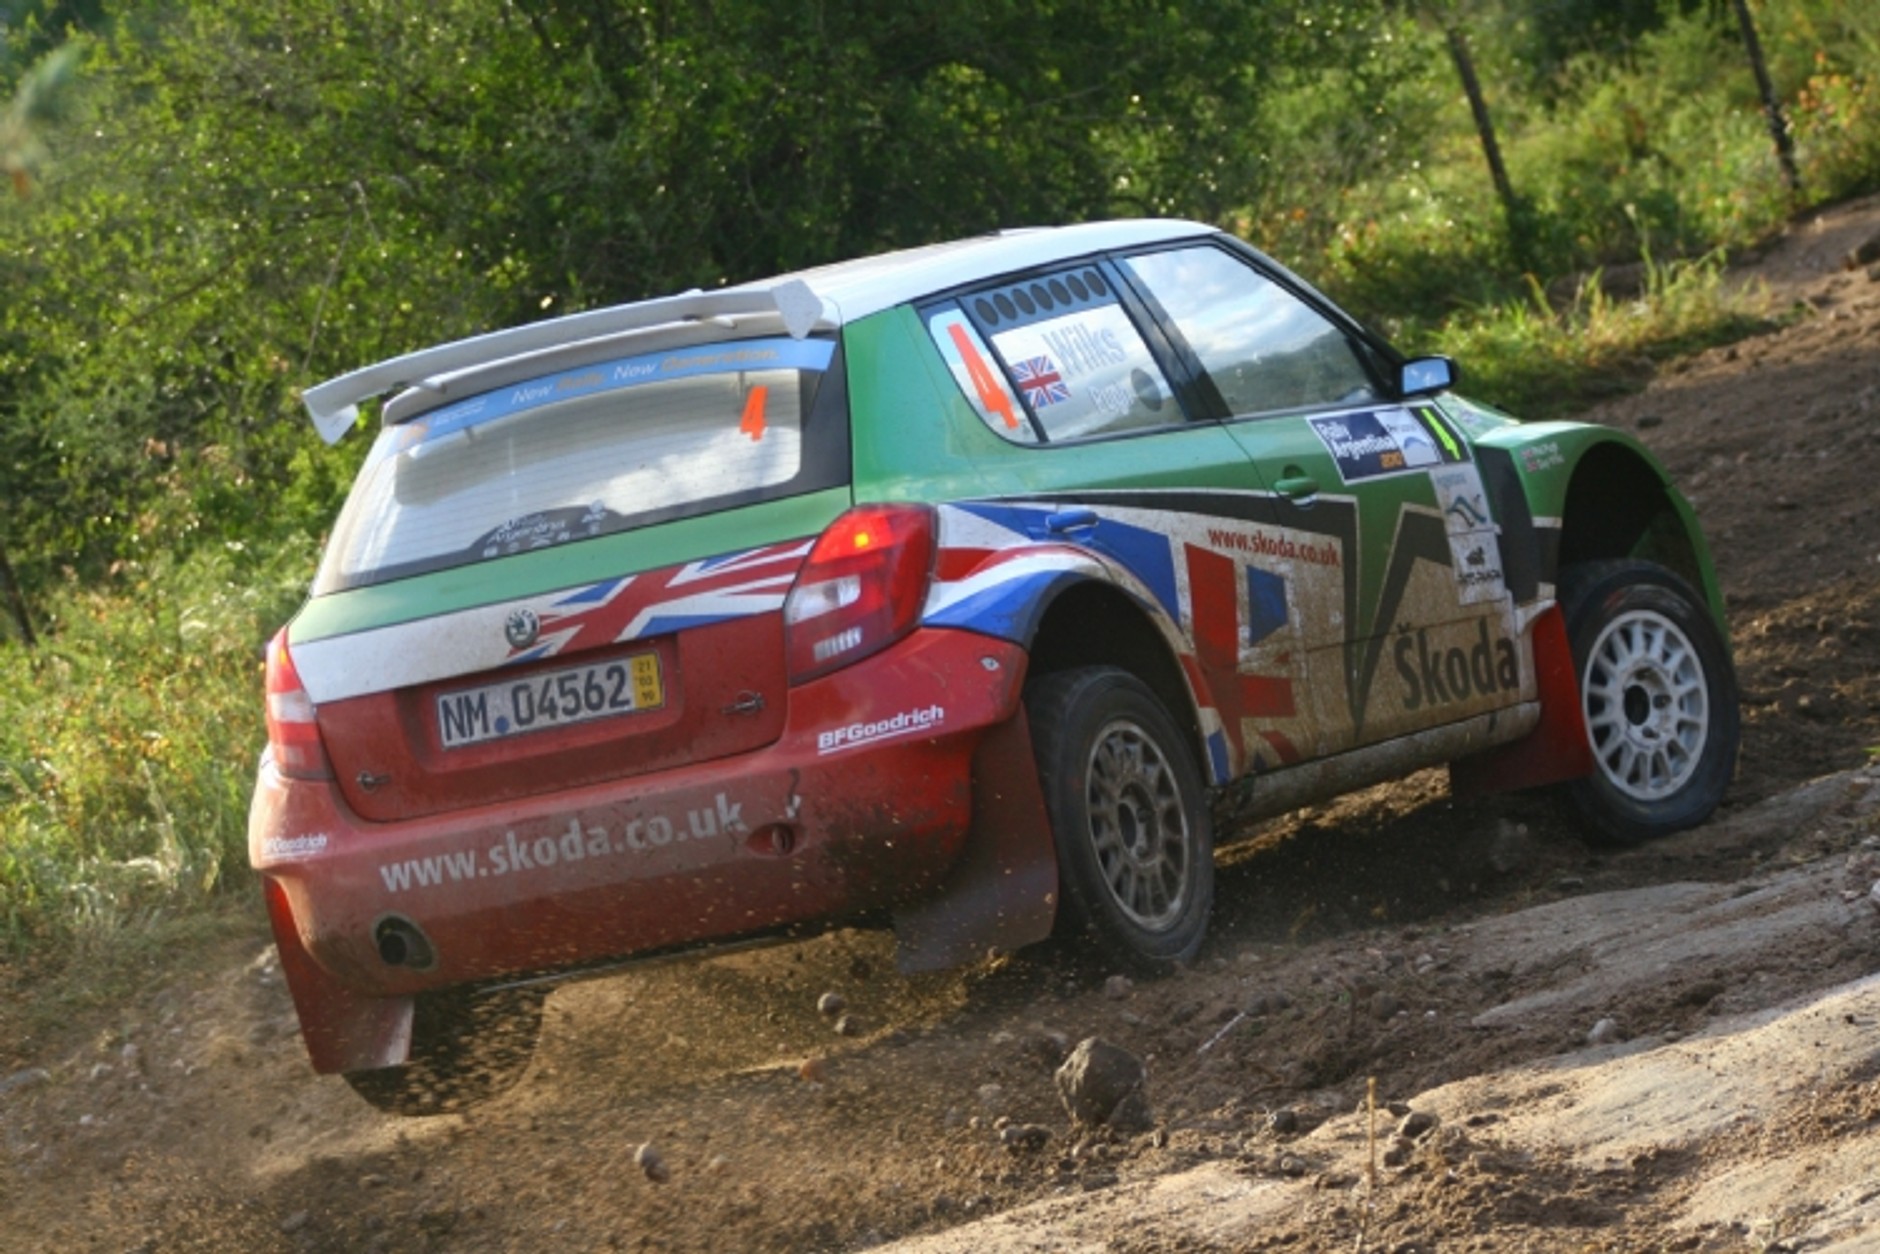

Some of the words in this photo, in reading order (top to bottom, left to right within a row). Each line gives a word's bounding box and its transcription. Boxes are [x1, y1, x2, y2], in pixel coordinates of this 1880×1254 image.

[947, 323, 1019, 429] 4
[1041, 322, 1128, 377] Wilks
[511, 384, 553, 405] New
[613, 362, 657, 381] New
[739, 384, 768, 442] 4
[1421, 408, 1460, 461] 4
[1330, 434, 1398, 461] Argentina
[1208, 529, 1341, 567] www.skoda.co.uk
[1395, 615, 1520, 710] Škoda
[440, 692, 490, 742] NM
[511, 664, 632, 727] 04562
[818, 704, 944, 750] BFGoodrich
[380, 792, 748, 892] www.skoda.co.uk
